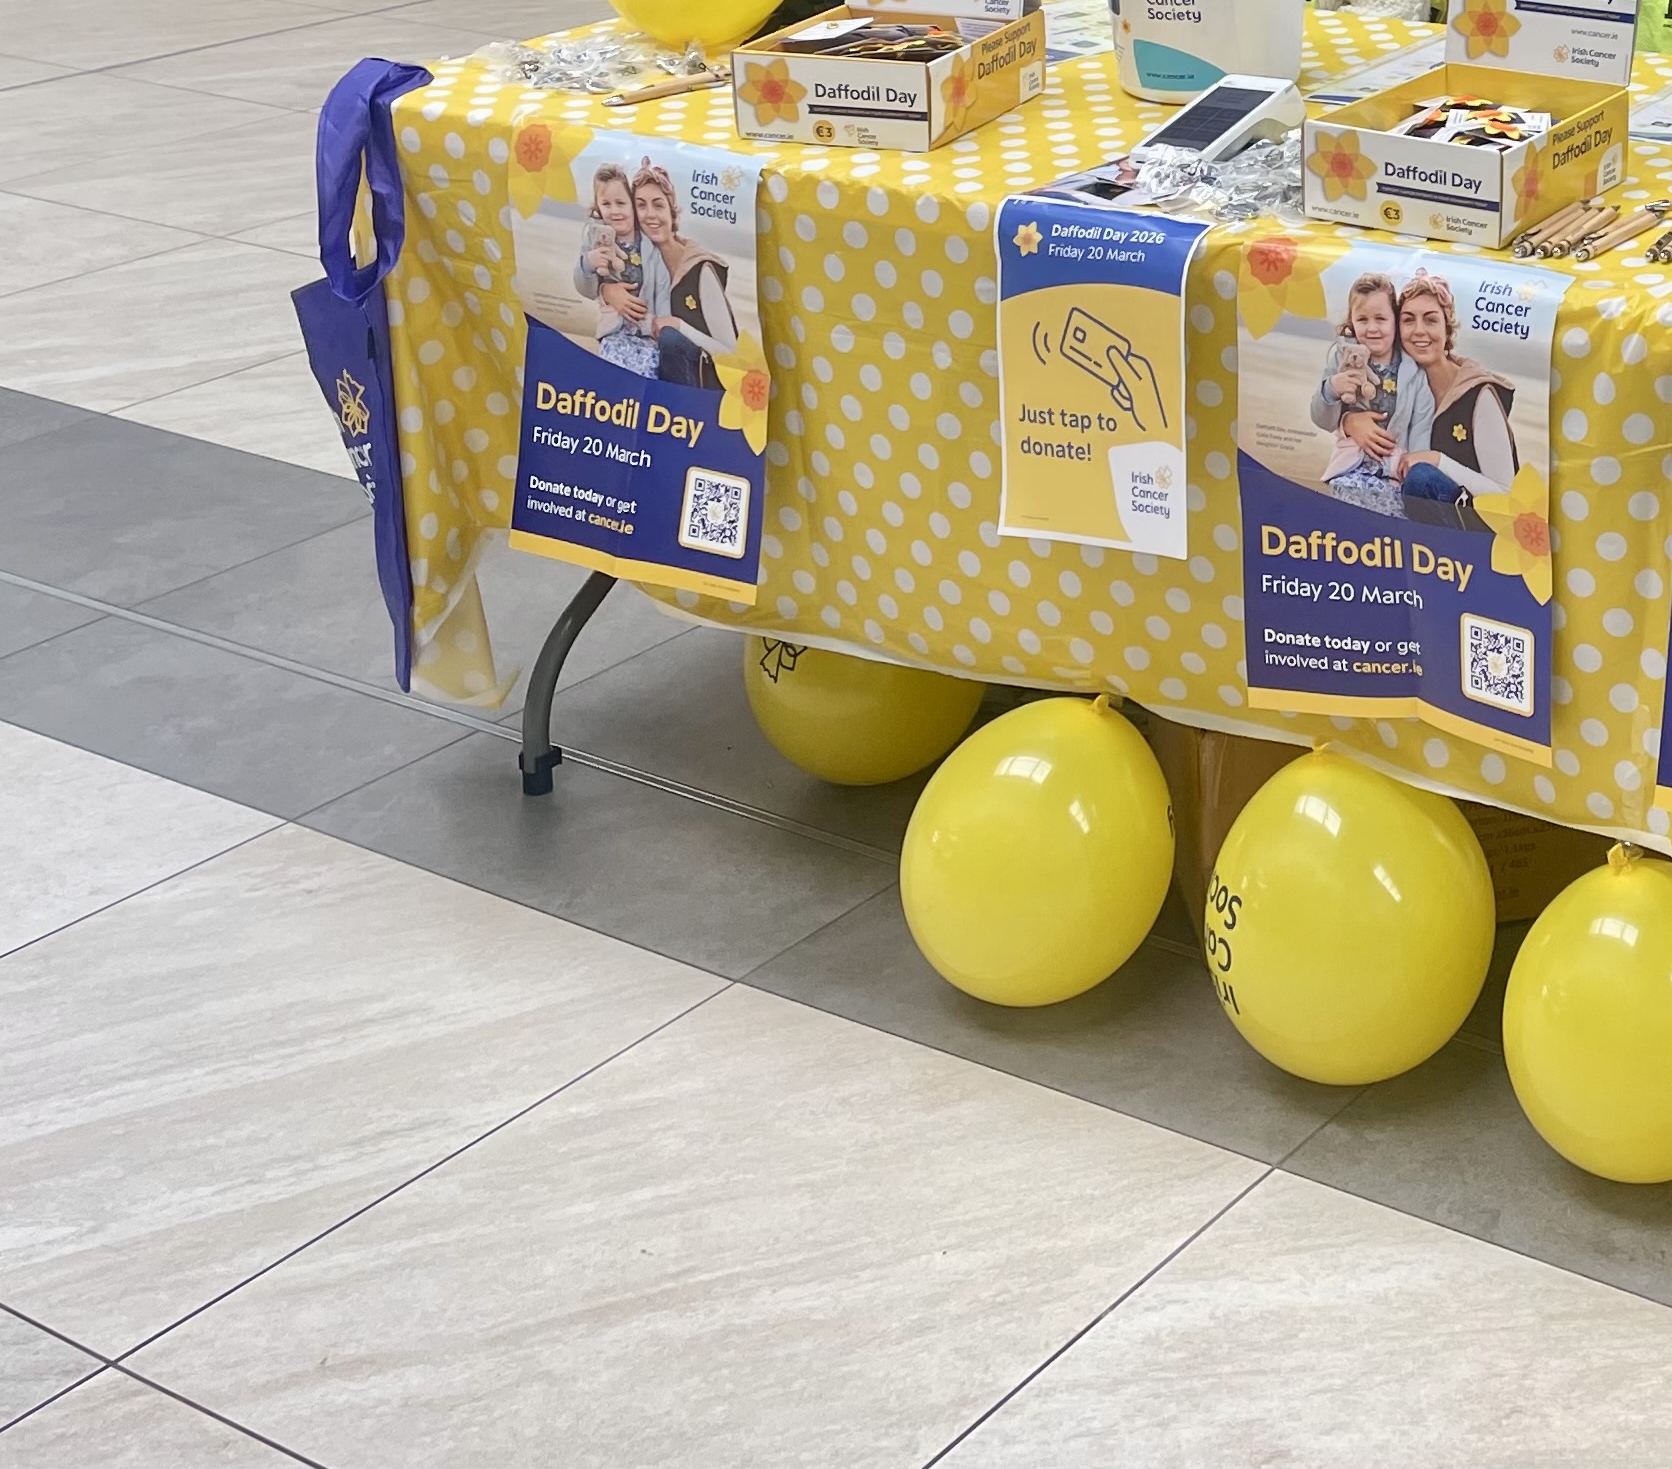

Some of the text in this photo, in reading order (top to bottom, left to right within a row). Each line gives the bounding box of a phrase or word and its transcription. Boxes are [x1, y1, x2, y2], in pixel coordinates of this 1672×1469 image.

[1147, 7, 1202, 23] Society
[977, 38, 1037, 80] Daffodil Day
[1571, 56, 1600, 68] Society
[1572, 47, 1616, 60] Irish Cancer
[814, 83, 917, 107] Daffodil Day
[816, 125, 832, 138] €3
[1553, 109, 1604, 146] Please Support
[1552, 126, 1613, 170] Daffodil Day
[692, 169, 718, 186] Irish
[1384, 162, 1482, 194] Daffodil Day
[690, 186, 735, 205] Cancer
[690, 202, 737, 224] Society
[1384, 206, 1400, 221] €3
[1051, 223, 1166, 245] Daffodil Day 2026
[1048, 243, 1145, 264] Friday 20 March
[1478, 280, 1513, 297] Irish
[1474, 297, 1532, 318] Cancer
[1471, 315, 1530, 340] Society
[536, 381, 704, 448] Daffodil Day
[1018, 403, 1118, 433] Just tap to
[533, 426, 652, 468] Friday 20 March
[1020, 436, 1092, 462] donate!
[1131, 471, 1154, 485] Irish
[529, 475, 638, 516] Donate today or get
[1131, 486, 1169, 502] Cancer
[527, 495, 573, 519] involved
[574, 508, 586, 522] at
[1131, 501, 1171, 519] Society
[1261, 525, 1474, 592] Daffodil Day
[1261, 574, 1423, 609] Friday 20 March
[1264, 628, 1421, 656] Donate today or get
[1264, 650, 1423, 677] involved at cancer.ie
